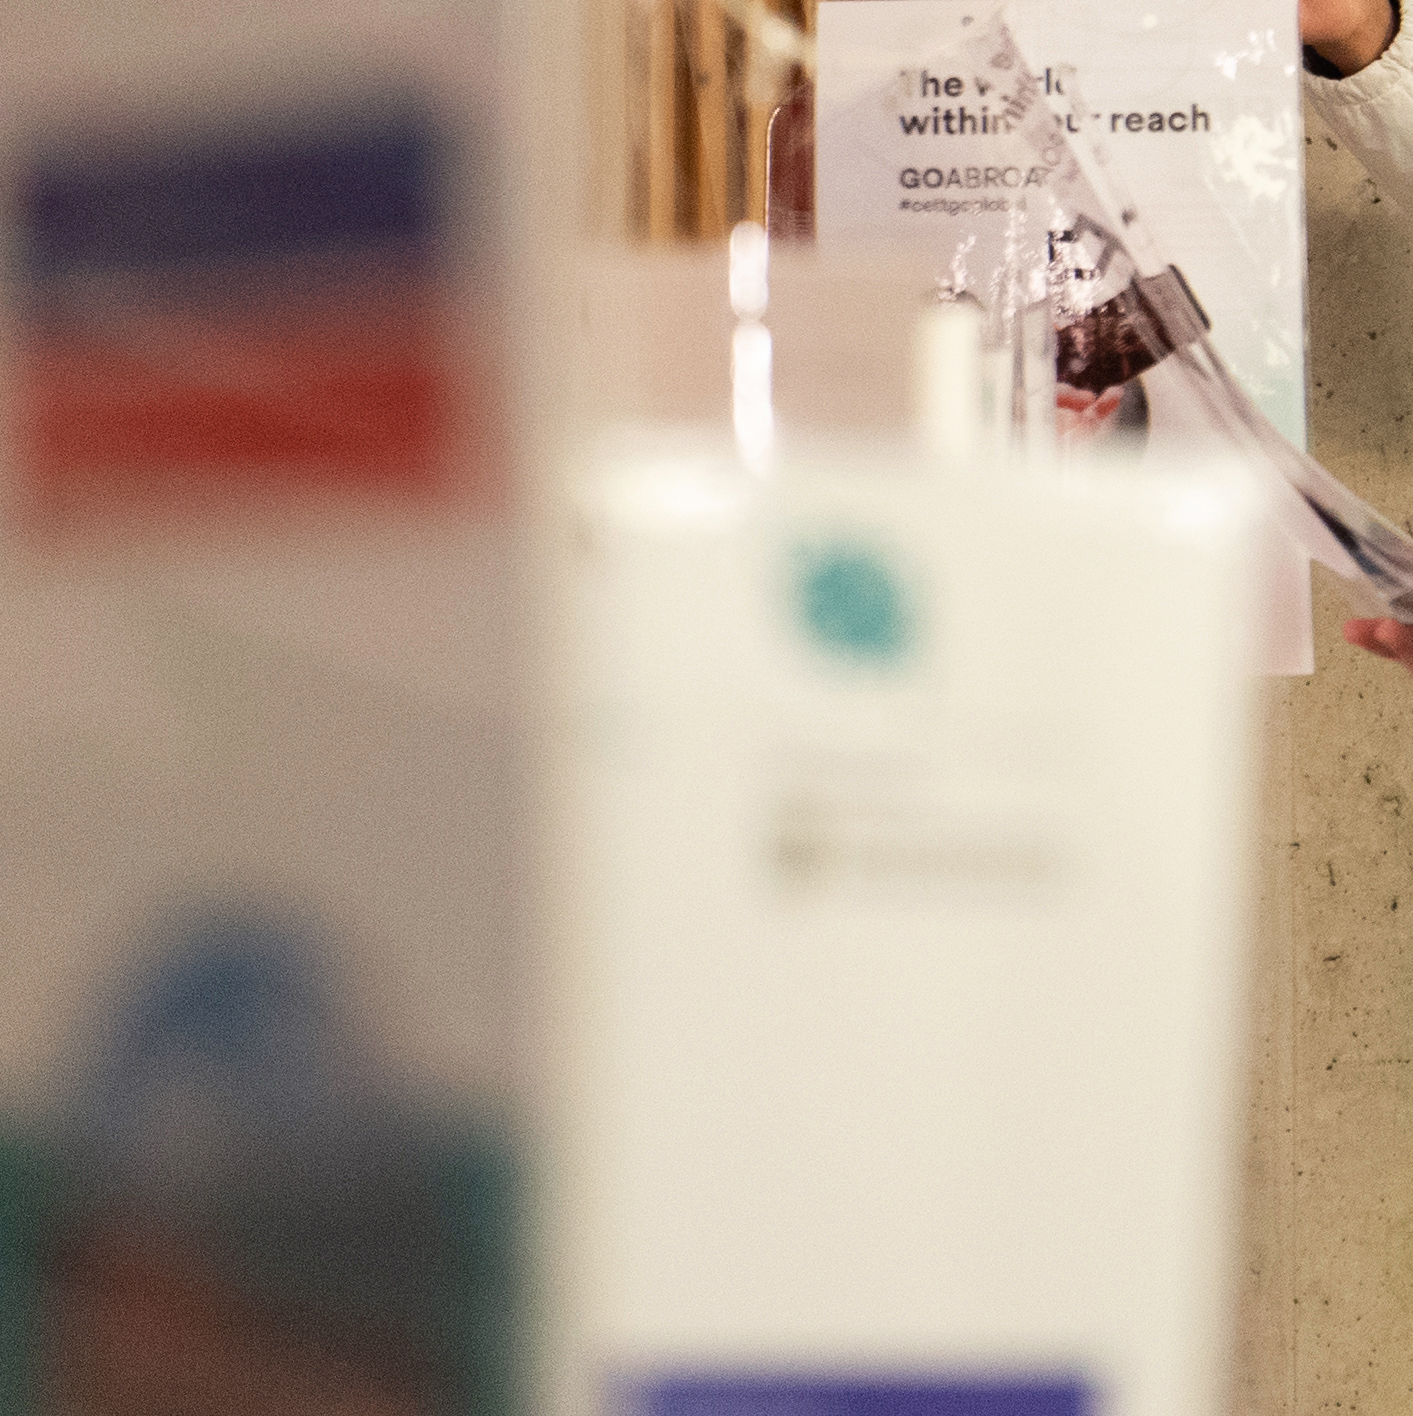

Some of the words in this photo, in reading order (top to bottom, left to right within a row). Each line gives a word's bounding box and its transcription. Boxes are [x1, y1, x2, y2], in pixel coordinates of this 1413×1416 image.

[900, 68, 964, 97] he
[1110, 103, 1211, 133] reach
[900, 166, 1048, 189] GOABROA
